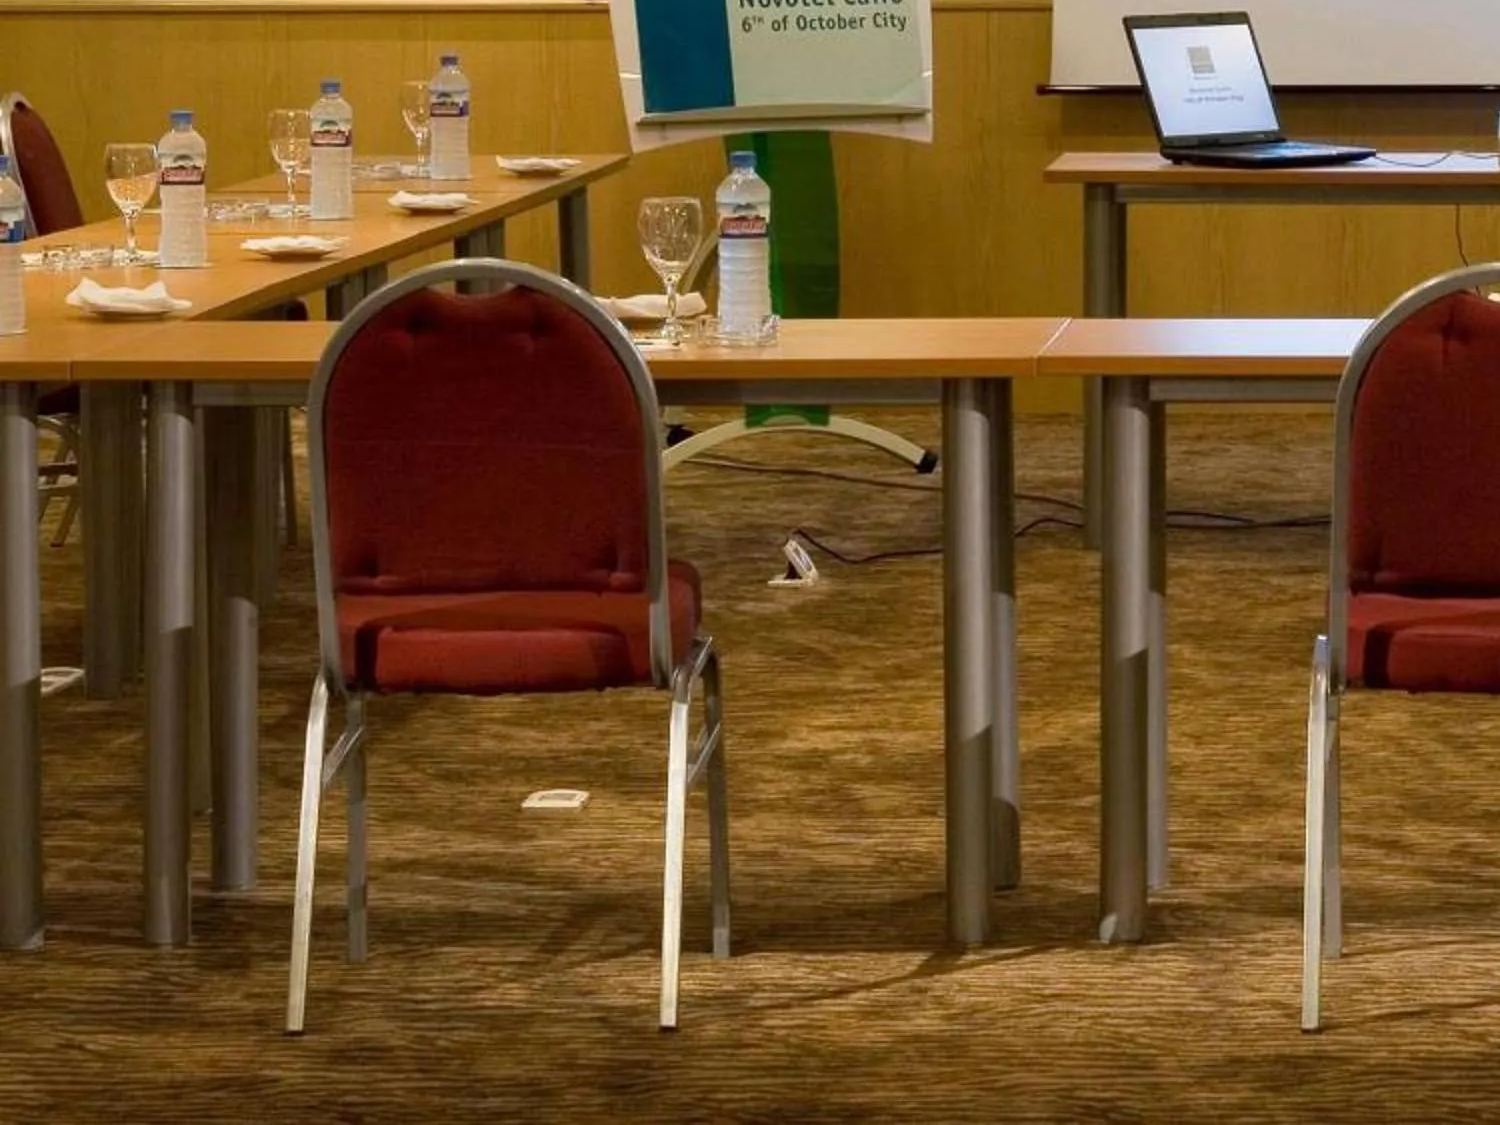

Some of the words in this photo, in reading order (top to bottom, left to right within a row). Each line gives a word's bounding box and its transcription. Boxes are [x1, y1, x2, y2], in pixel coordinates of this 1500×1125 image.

[771, 15, 788, 32] of
[796, 12, 867, 31] October
[872, 11, 908, 32] City
